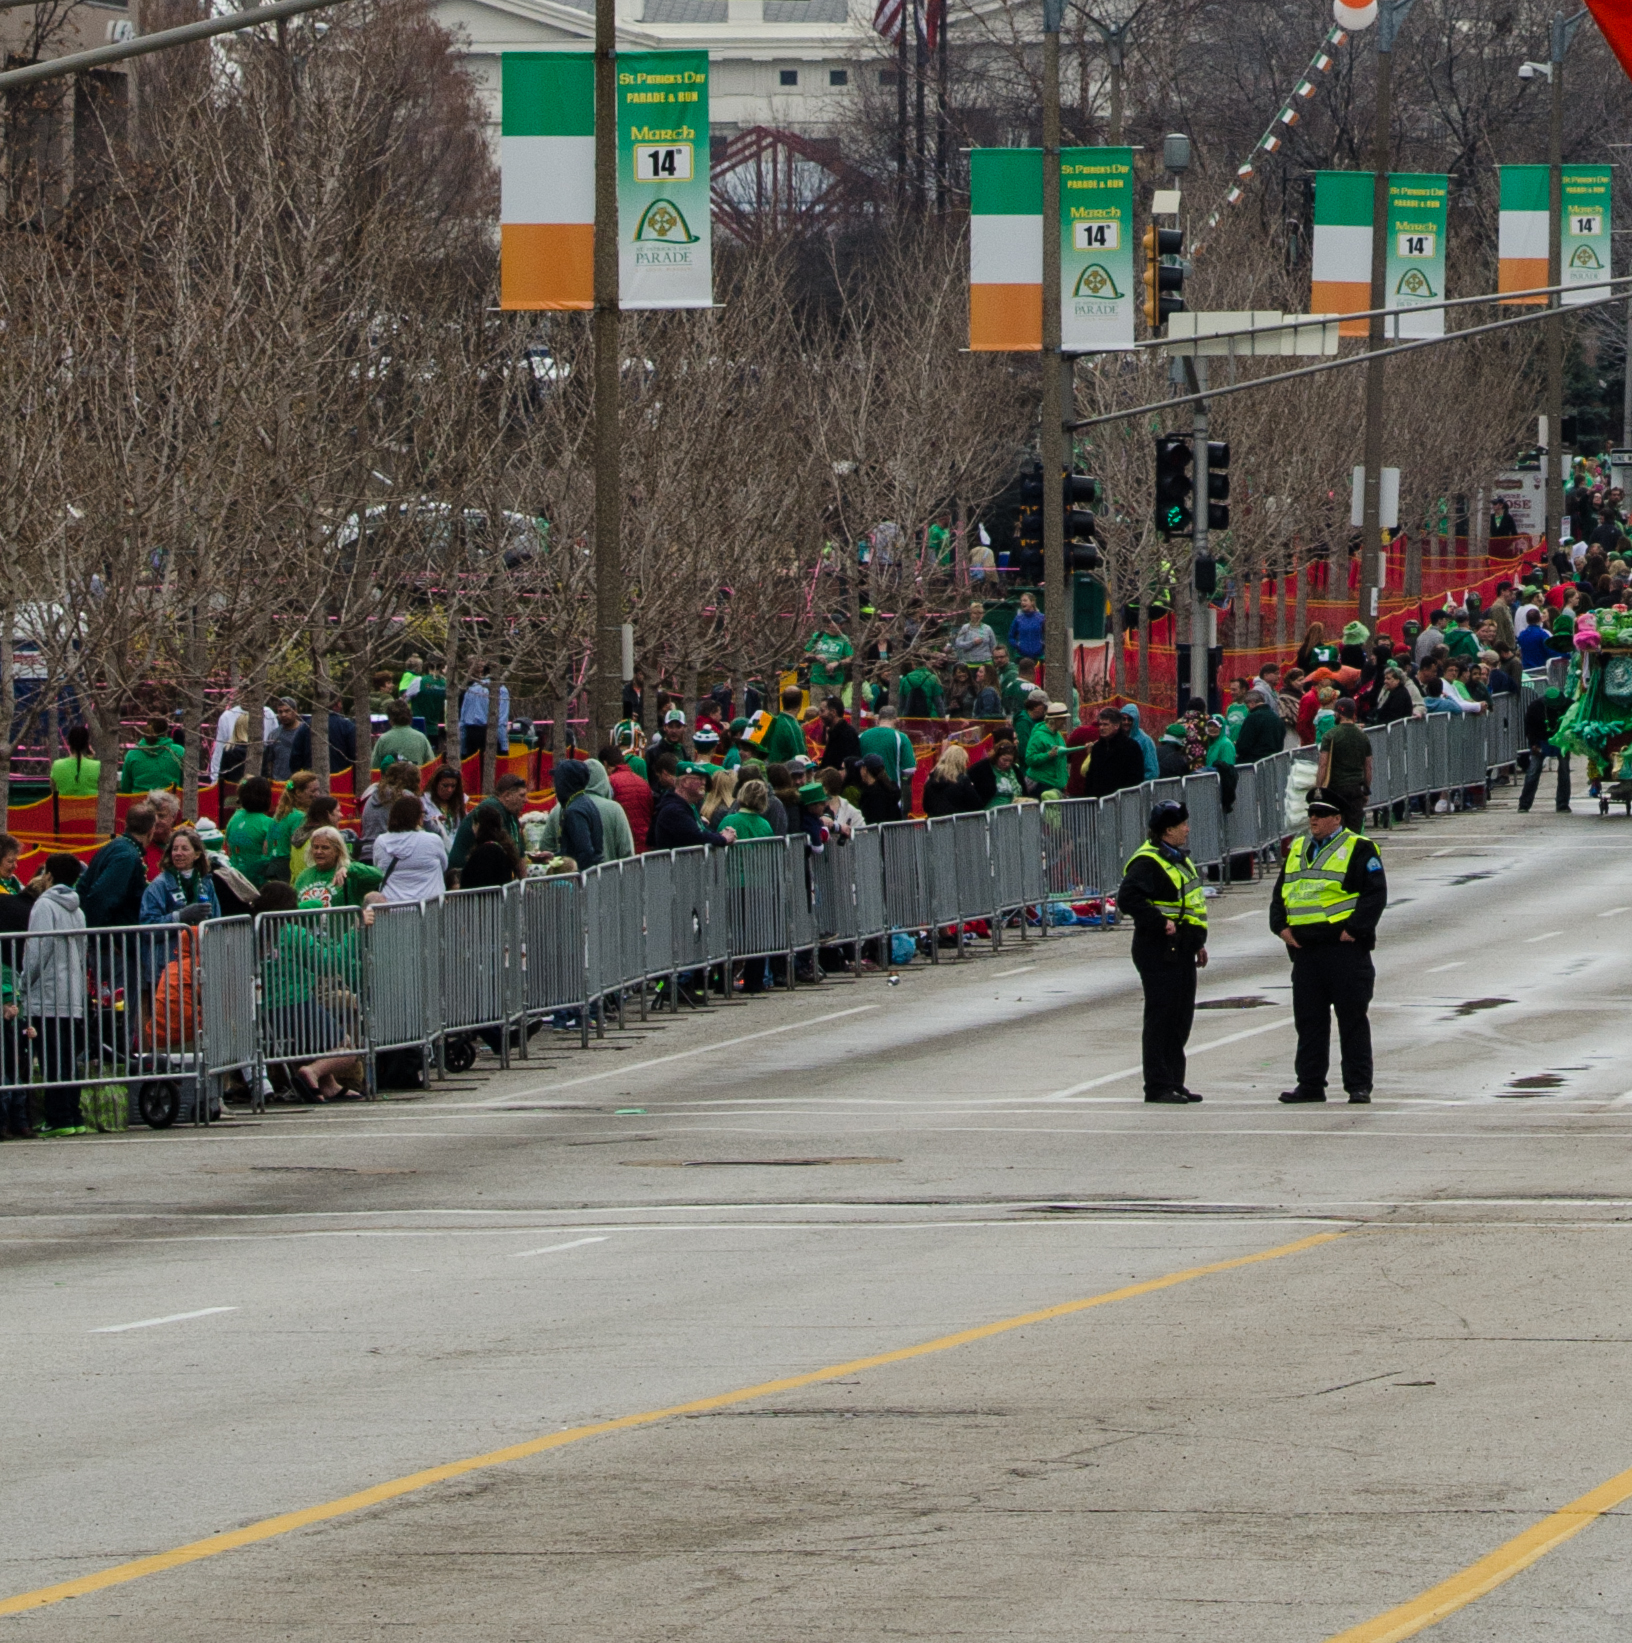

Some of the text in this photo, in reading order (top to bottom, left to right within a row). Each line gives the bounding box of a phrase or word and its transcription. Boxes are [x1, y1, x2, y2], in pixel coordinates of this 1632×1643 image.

[627, 91, 699, 104] PARADE & RUN
[630, 125, 696, 140] March
[1070, 206, 1122, 218] March
[636, 252, 693, 265] PARADE
[1075, 305, 1119, 315] PARADE
[1613, 454, 1625, 462] ONE
